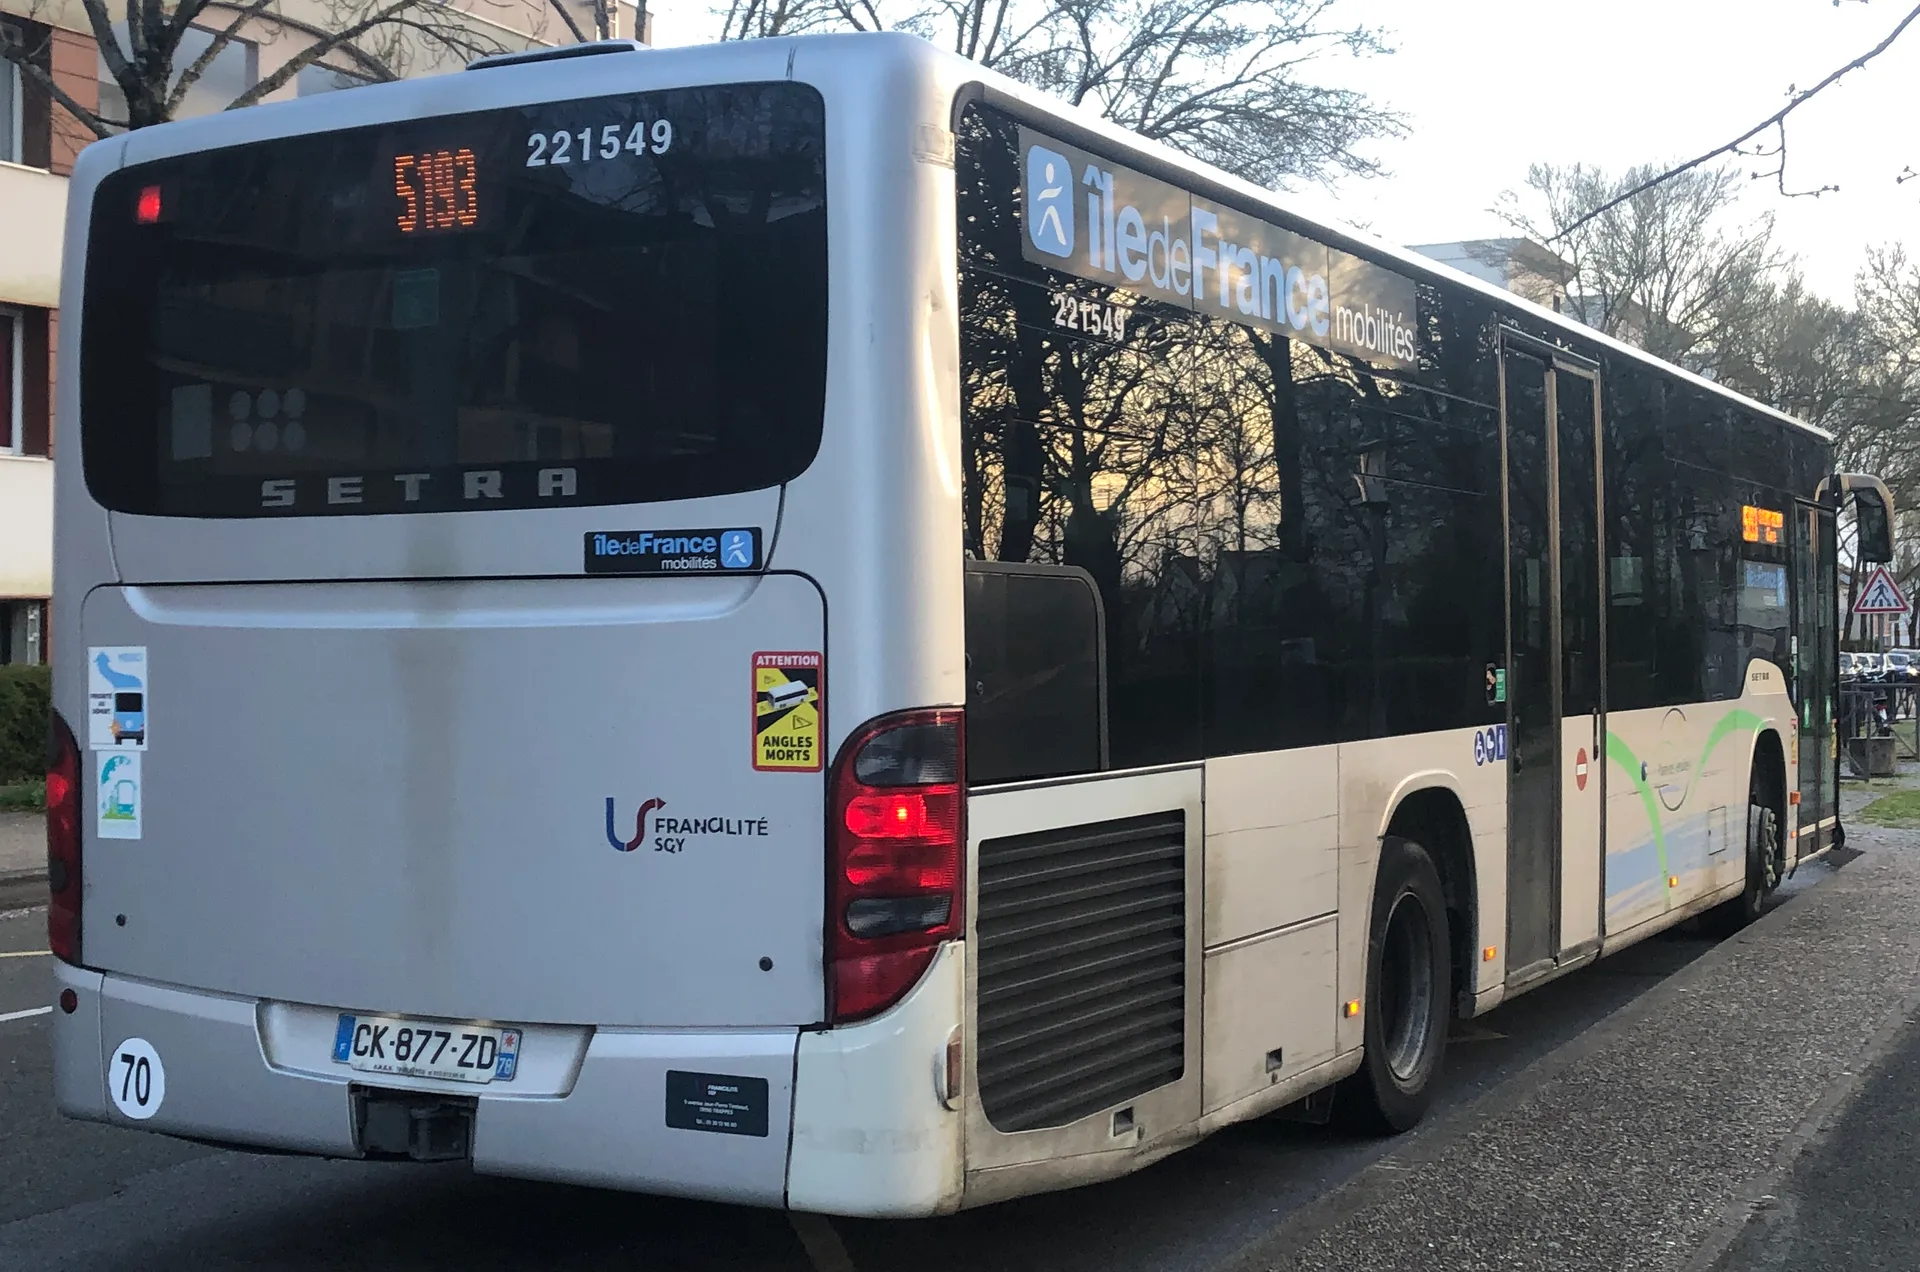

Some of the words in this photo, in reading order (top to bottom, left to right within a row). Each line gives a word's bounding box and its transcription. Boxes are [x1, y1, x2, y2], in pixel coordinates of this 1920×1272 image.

[526, 119, 672, 167] 221549
[395, 149, 477, 232] 5193
[1053, 292, 1125, 341] 221549
[1336, 303, 1414, 363] mobilités
[261, 467, 578, 507] SETRA
[661, 555, 717, 570] mobilités
[756, 655, 819, 666] ATTENTION
[763, 736, 813, 748] ANGLES
[765, 749, 811, 761] MORTS
[654, 816, 769, 836] FRANCILITÉ
[339, 1043, 346, 1053] F
[353, 1024, 497, 1070] CK-877-ZD
[120, 1053, 151, 1106] 70
[498, 1057, 512, 1074] 78
